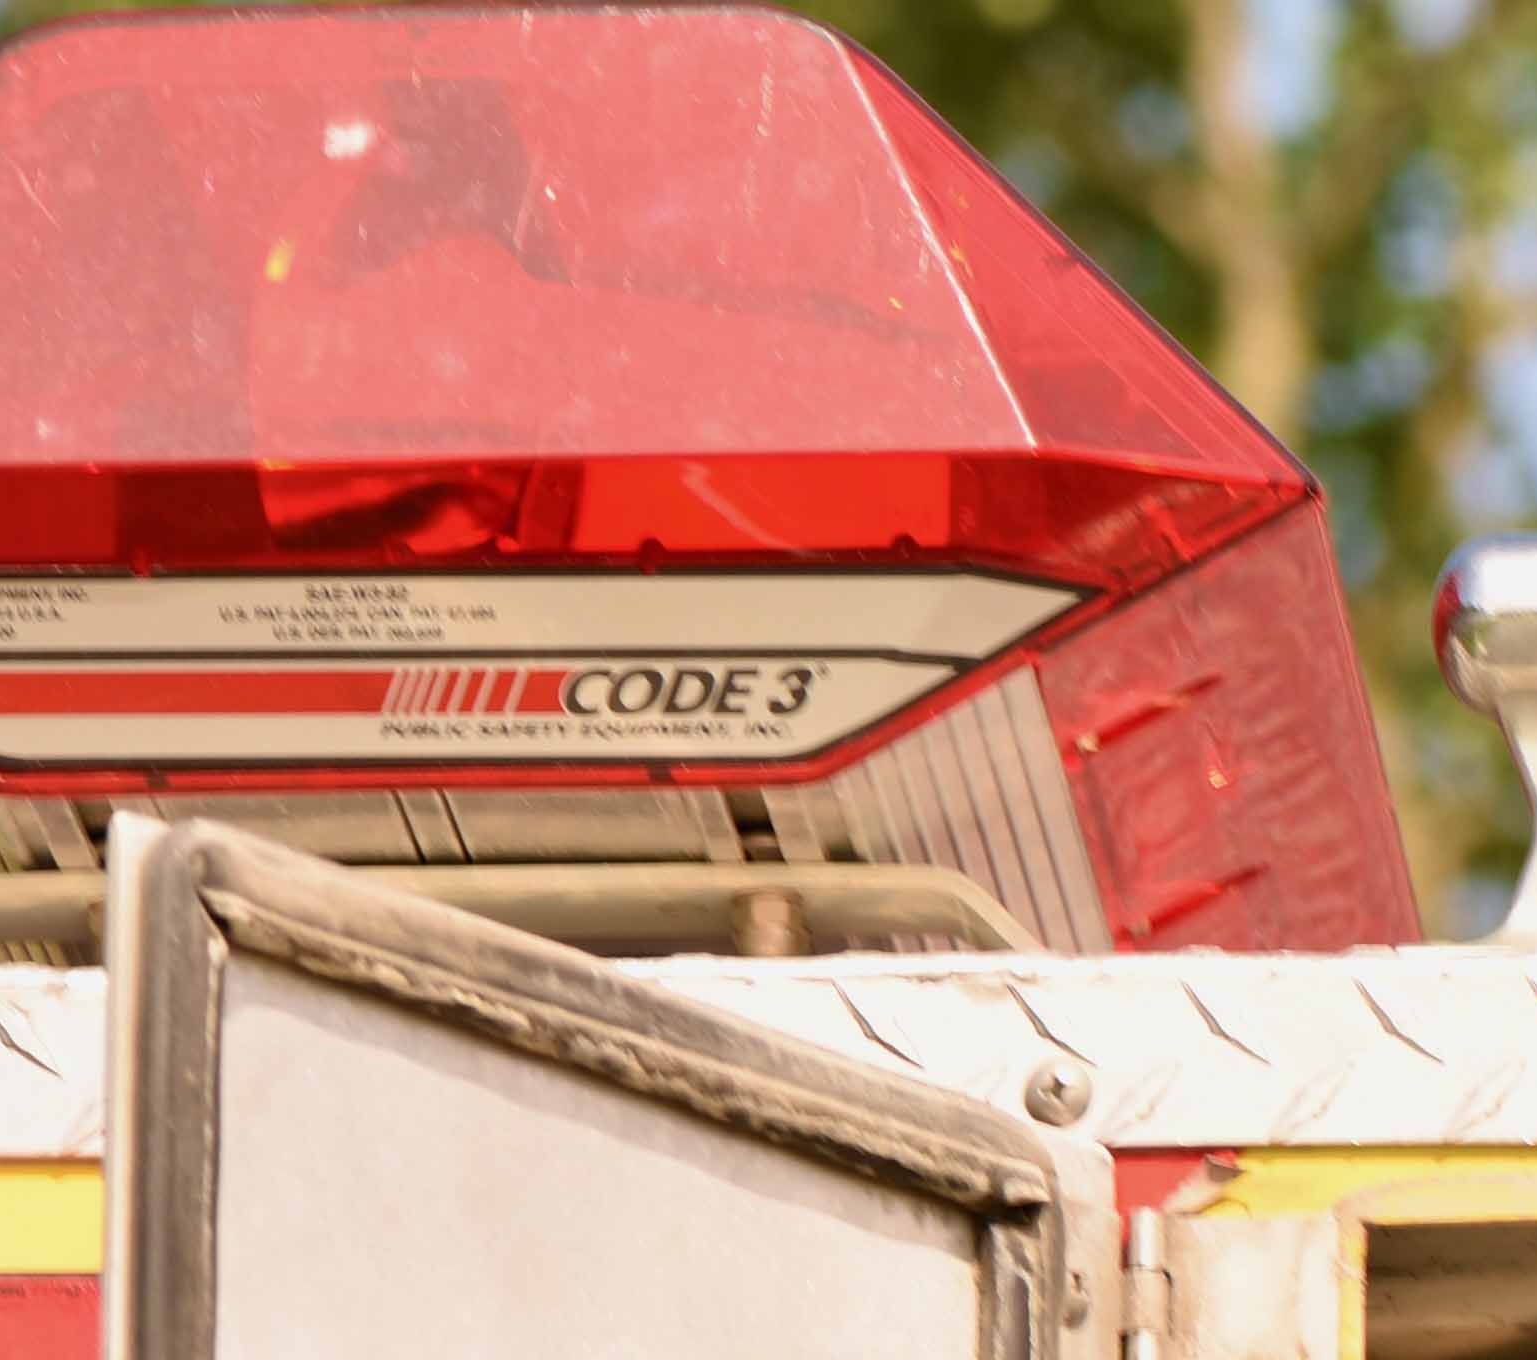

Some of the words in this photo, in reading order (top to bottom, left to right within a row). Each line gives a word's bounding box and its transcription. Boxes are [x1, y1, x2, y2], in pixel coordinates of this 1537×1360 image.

[566, 667, 758, 715] CODE
[767, 667, 813, 715] 3
[380, 720, 463, 740] PUBLIC
[477, 720, 570, 739] SAFETY
